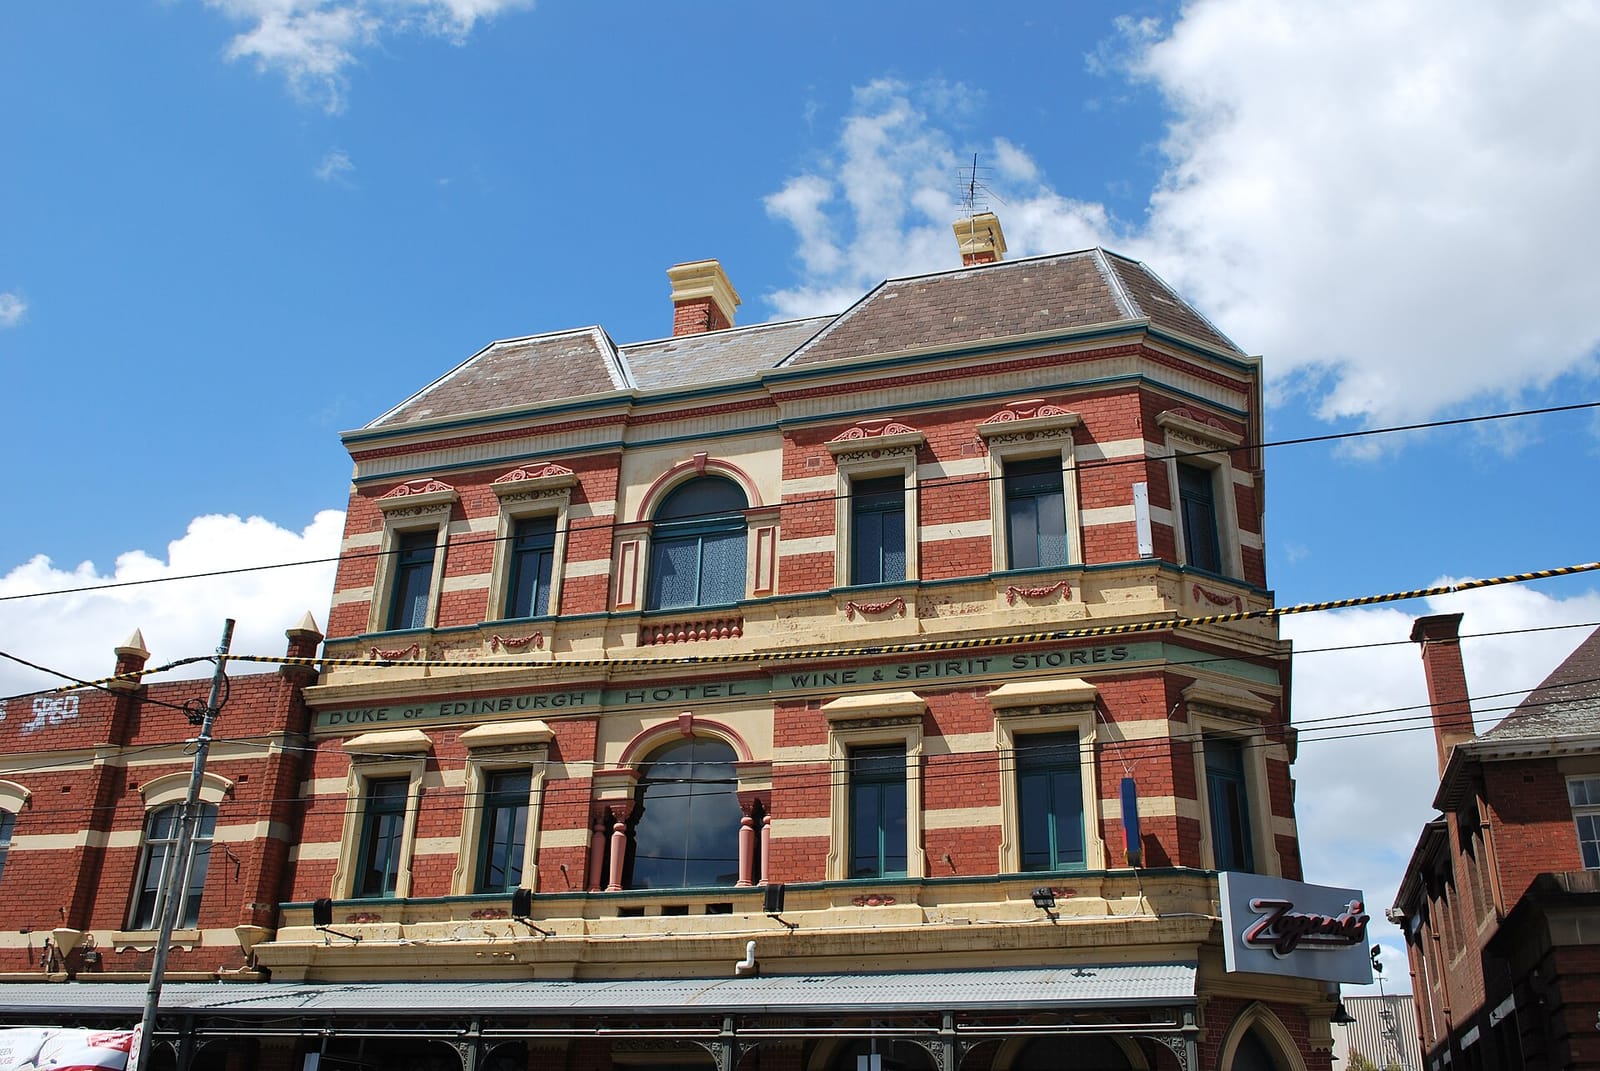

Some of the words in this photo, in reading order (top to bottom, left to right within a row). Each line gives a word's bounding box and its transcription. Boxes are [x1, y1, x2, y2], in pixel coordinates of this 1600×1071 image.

[791, 671, 857, 688] WINE
[872, 669, 884, 682] &
[895, 659, 993, 680] SPIRIT
[1012, 647, 1130, 670] STORES
[329, 708, 389, 725] DUKE
[403, 707, 424, 720] OF
[439, 692, 586, 717] EDINBURGH
[624, 683, 747, 704] HOTEL
